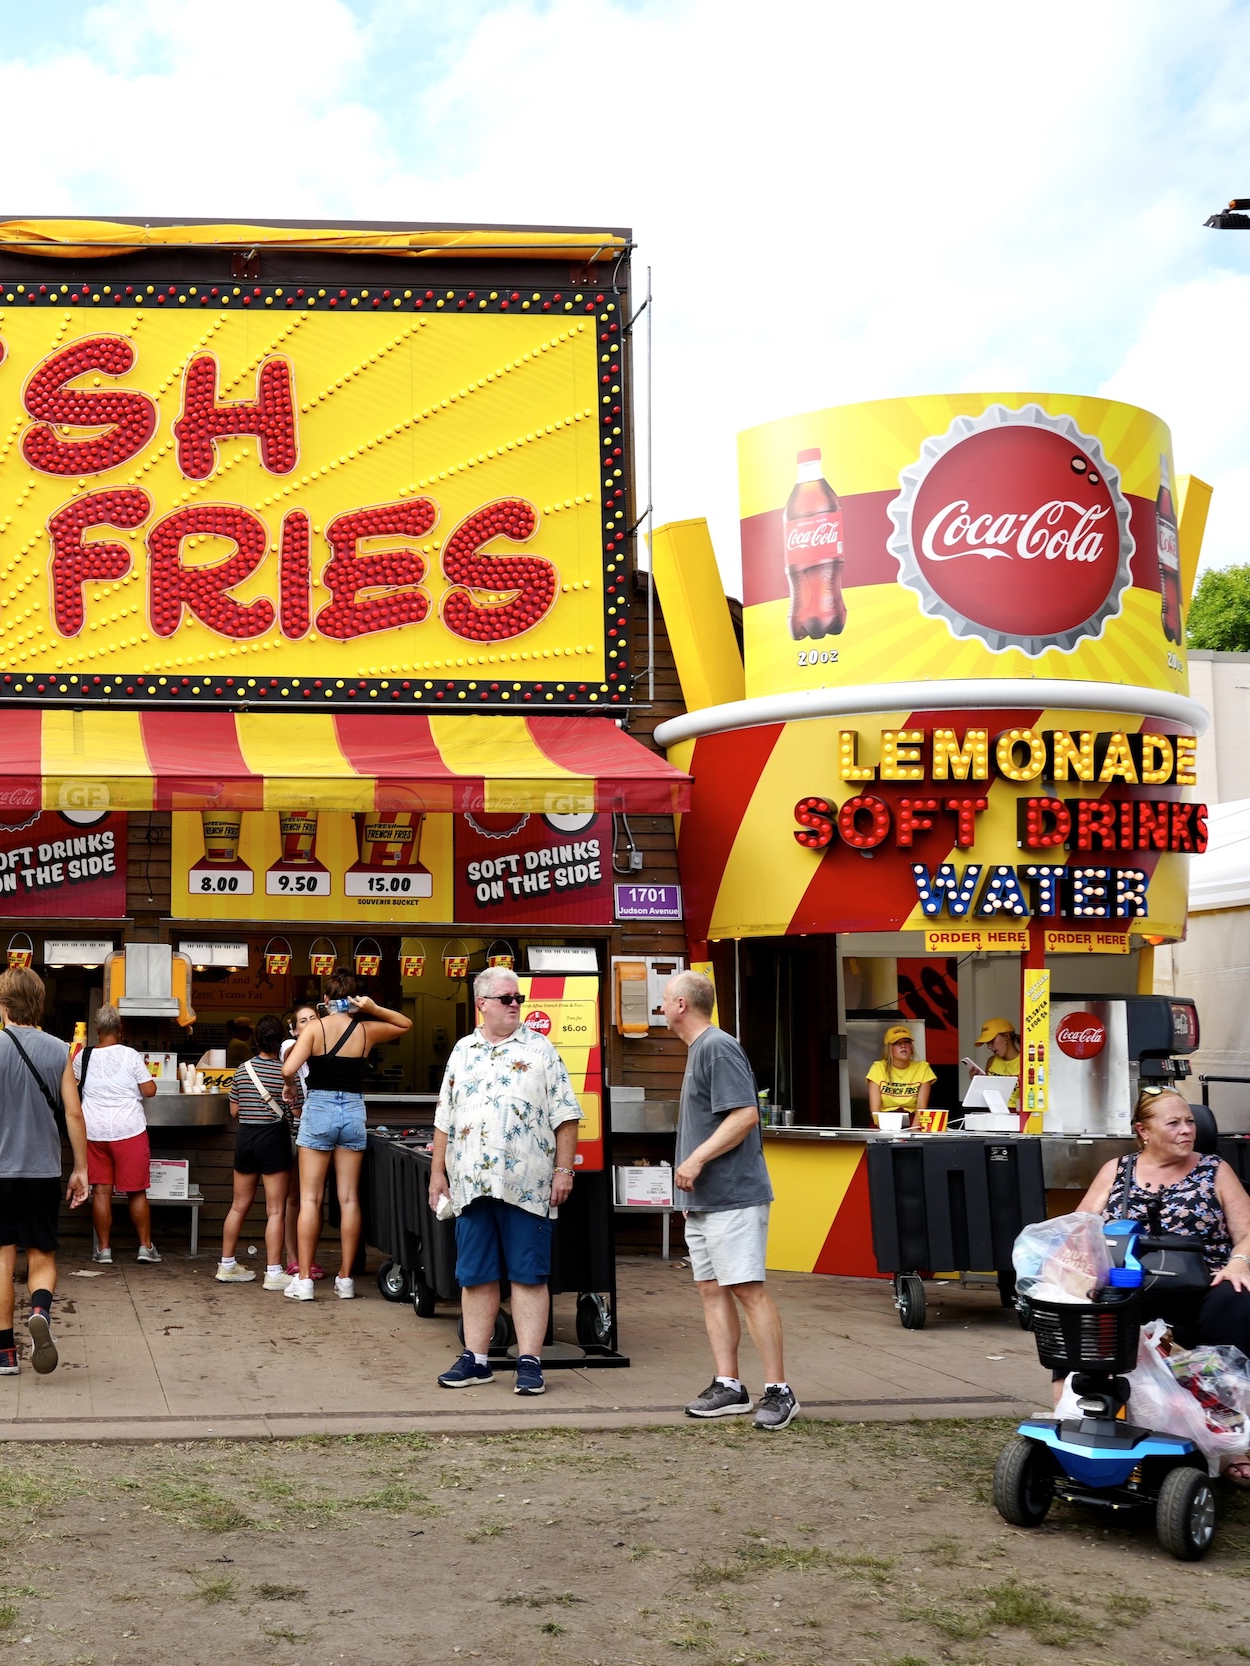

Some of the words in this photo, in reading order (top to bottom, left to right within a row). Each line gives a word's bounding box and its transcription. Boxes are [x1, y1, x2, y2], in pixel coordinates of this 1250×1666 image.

[788, 521, 839, 550] Coca-Cola
[922, 500, 1111, 562] Coca-Cola
[47, 485, 558, 643] FRIES
[838, 727, 1197, 786] LEMONADE
[367, 829, 392, 839] FRENCH
[394, 829, 412, 839] FRIES
[793, 795, 988, 849] SOFT
[1017, 796, 1208, 854] DRINKS
[37, 831, 115, 862] DRINKS
[21, 863, 64, 887] THE
[68, 853, 116, 878] SIDE
[468, 855, 520, 881] SOFT
[524, 839, 600, 870] DRINKS
[201, 877, 238, 891] 8.00
[278, 876, 318, 891] 9.50
[367, 877, 411, 892] 15.00
[476, 880, 504, 901] ON
[507, 871, 551, 894] THE
[555, 861, 601, 886] SIDE
[910, 863, 1148, 918] WATER
[629, 888, 666, 902] 1701
[619, 907, 648, 915] Judson
[649, 907, 678, 915] Avenue
[929, 932, 981, 943] ORDER
[988, 932, 1026, 942] HERE
[1048, 933, 1091, 944] ORDER
[1096, 935, 1126, 945] HERE
[218, 990, 245, 999] Trans
[248, 991, 262, 999] Fat
[1058, 1027, 1104, 1043] Coca-Cola
